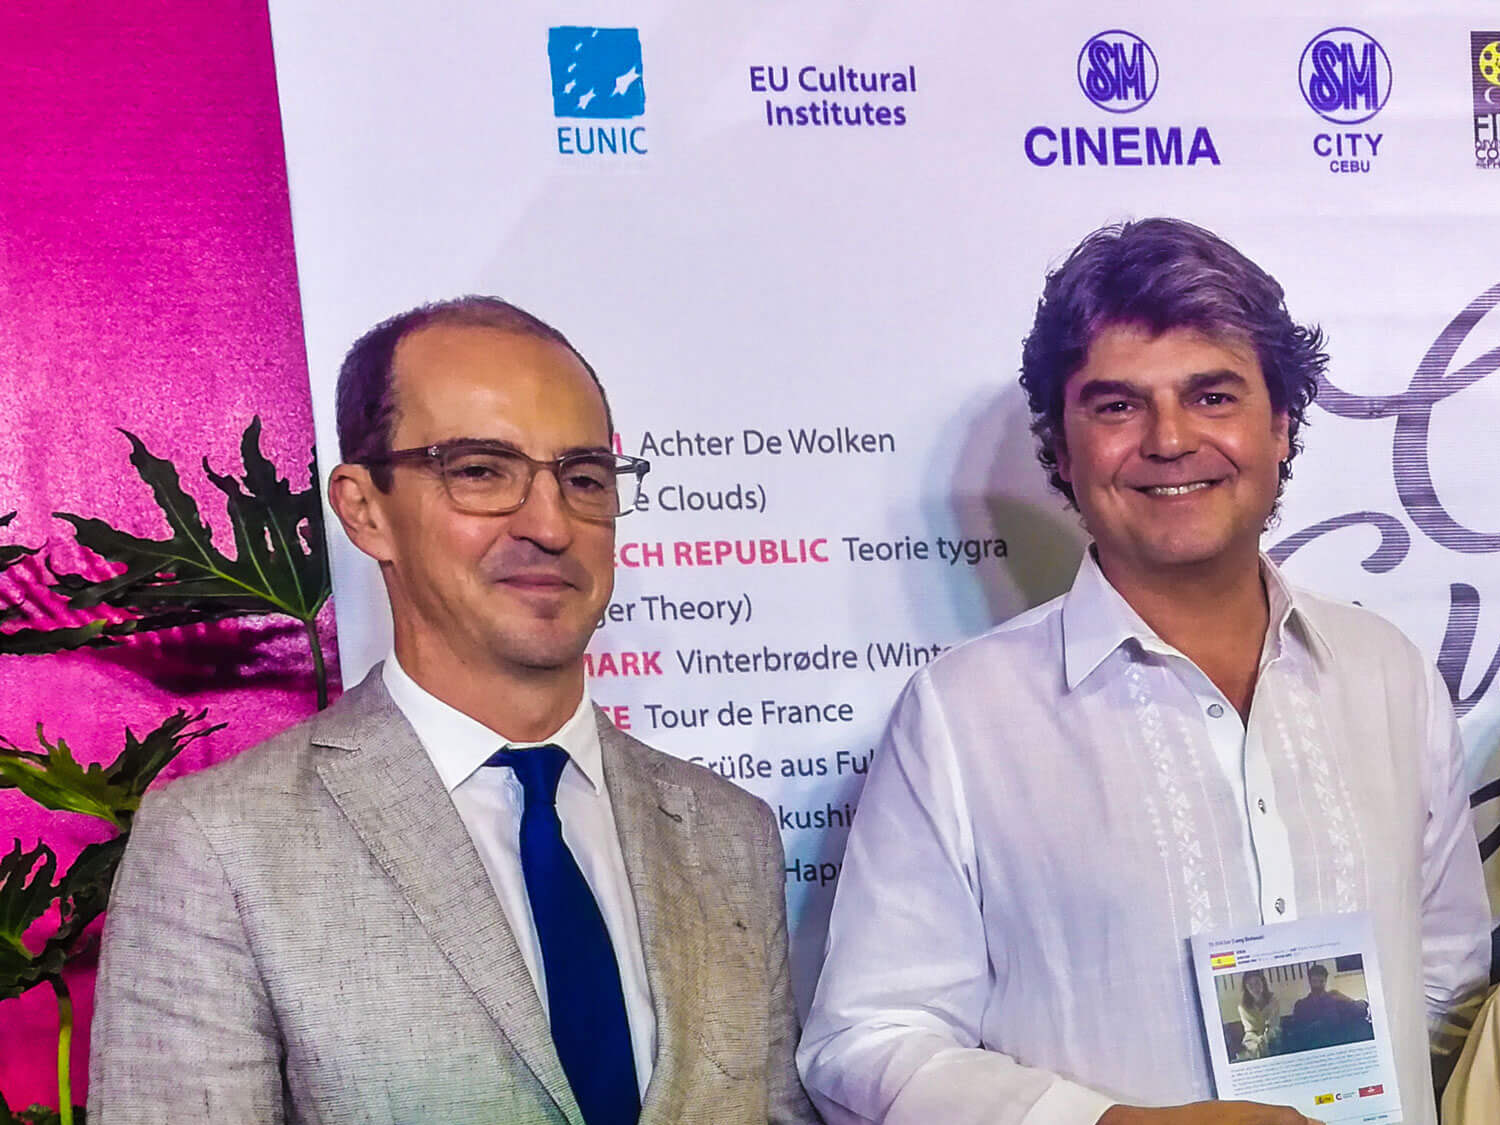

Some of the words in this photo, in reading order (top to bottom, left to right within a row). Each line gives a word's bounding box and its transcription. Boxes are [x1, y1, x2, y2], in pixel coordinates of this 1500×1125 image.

[750, 67, 790, 93] EU
[798, 65, 917, 94] Cultural
[767, 100, 907, 127] Institutes
[557, 127, 648, 154] EUNIC
[1025, 126, 1221, 166] CINEMA
[1313, 134, 1382, 156] CITY
[1330, 160, 1370, 172] CEBU
[639, 430, 734, 457] Achter
[743, 430, 782, 455] De
[788, 426, 895, 454] Wolken
[658, 483, 766, 513] Clouds)
[674, 537, 829, 567] REPUBLIC
[842, 536, 928, 562] Teorie
[937, 536, 1008, 565] tygra
[641, 593, 752, 625] Theory)
[676, 643, 858, 675] Vinterbrødre
[644, 703, 709, 730] Tour
[717, 700, 752, 727] de
[762, 699, 854, 726] France
[781, 757, 827, 777] aus
